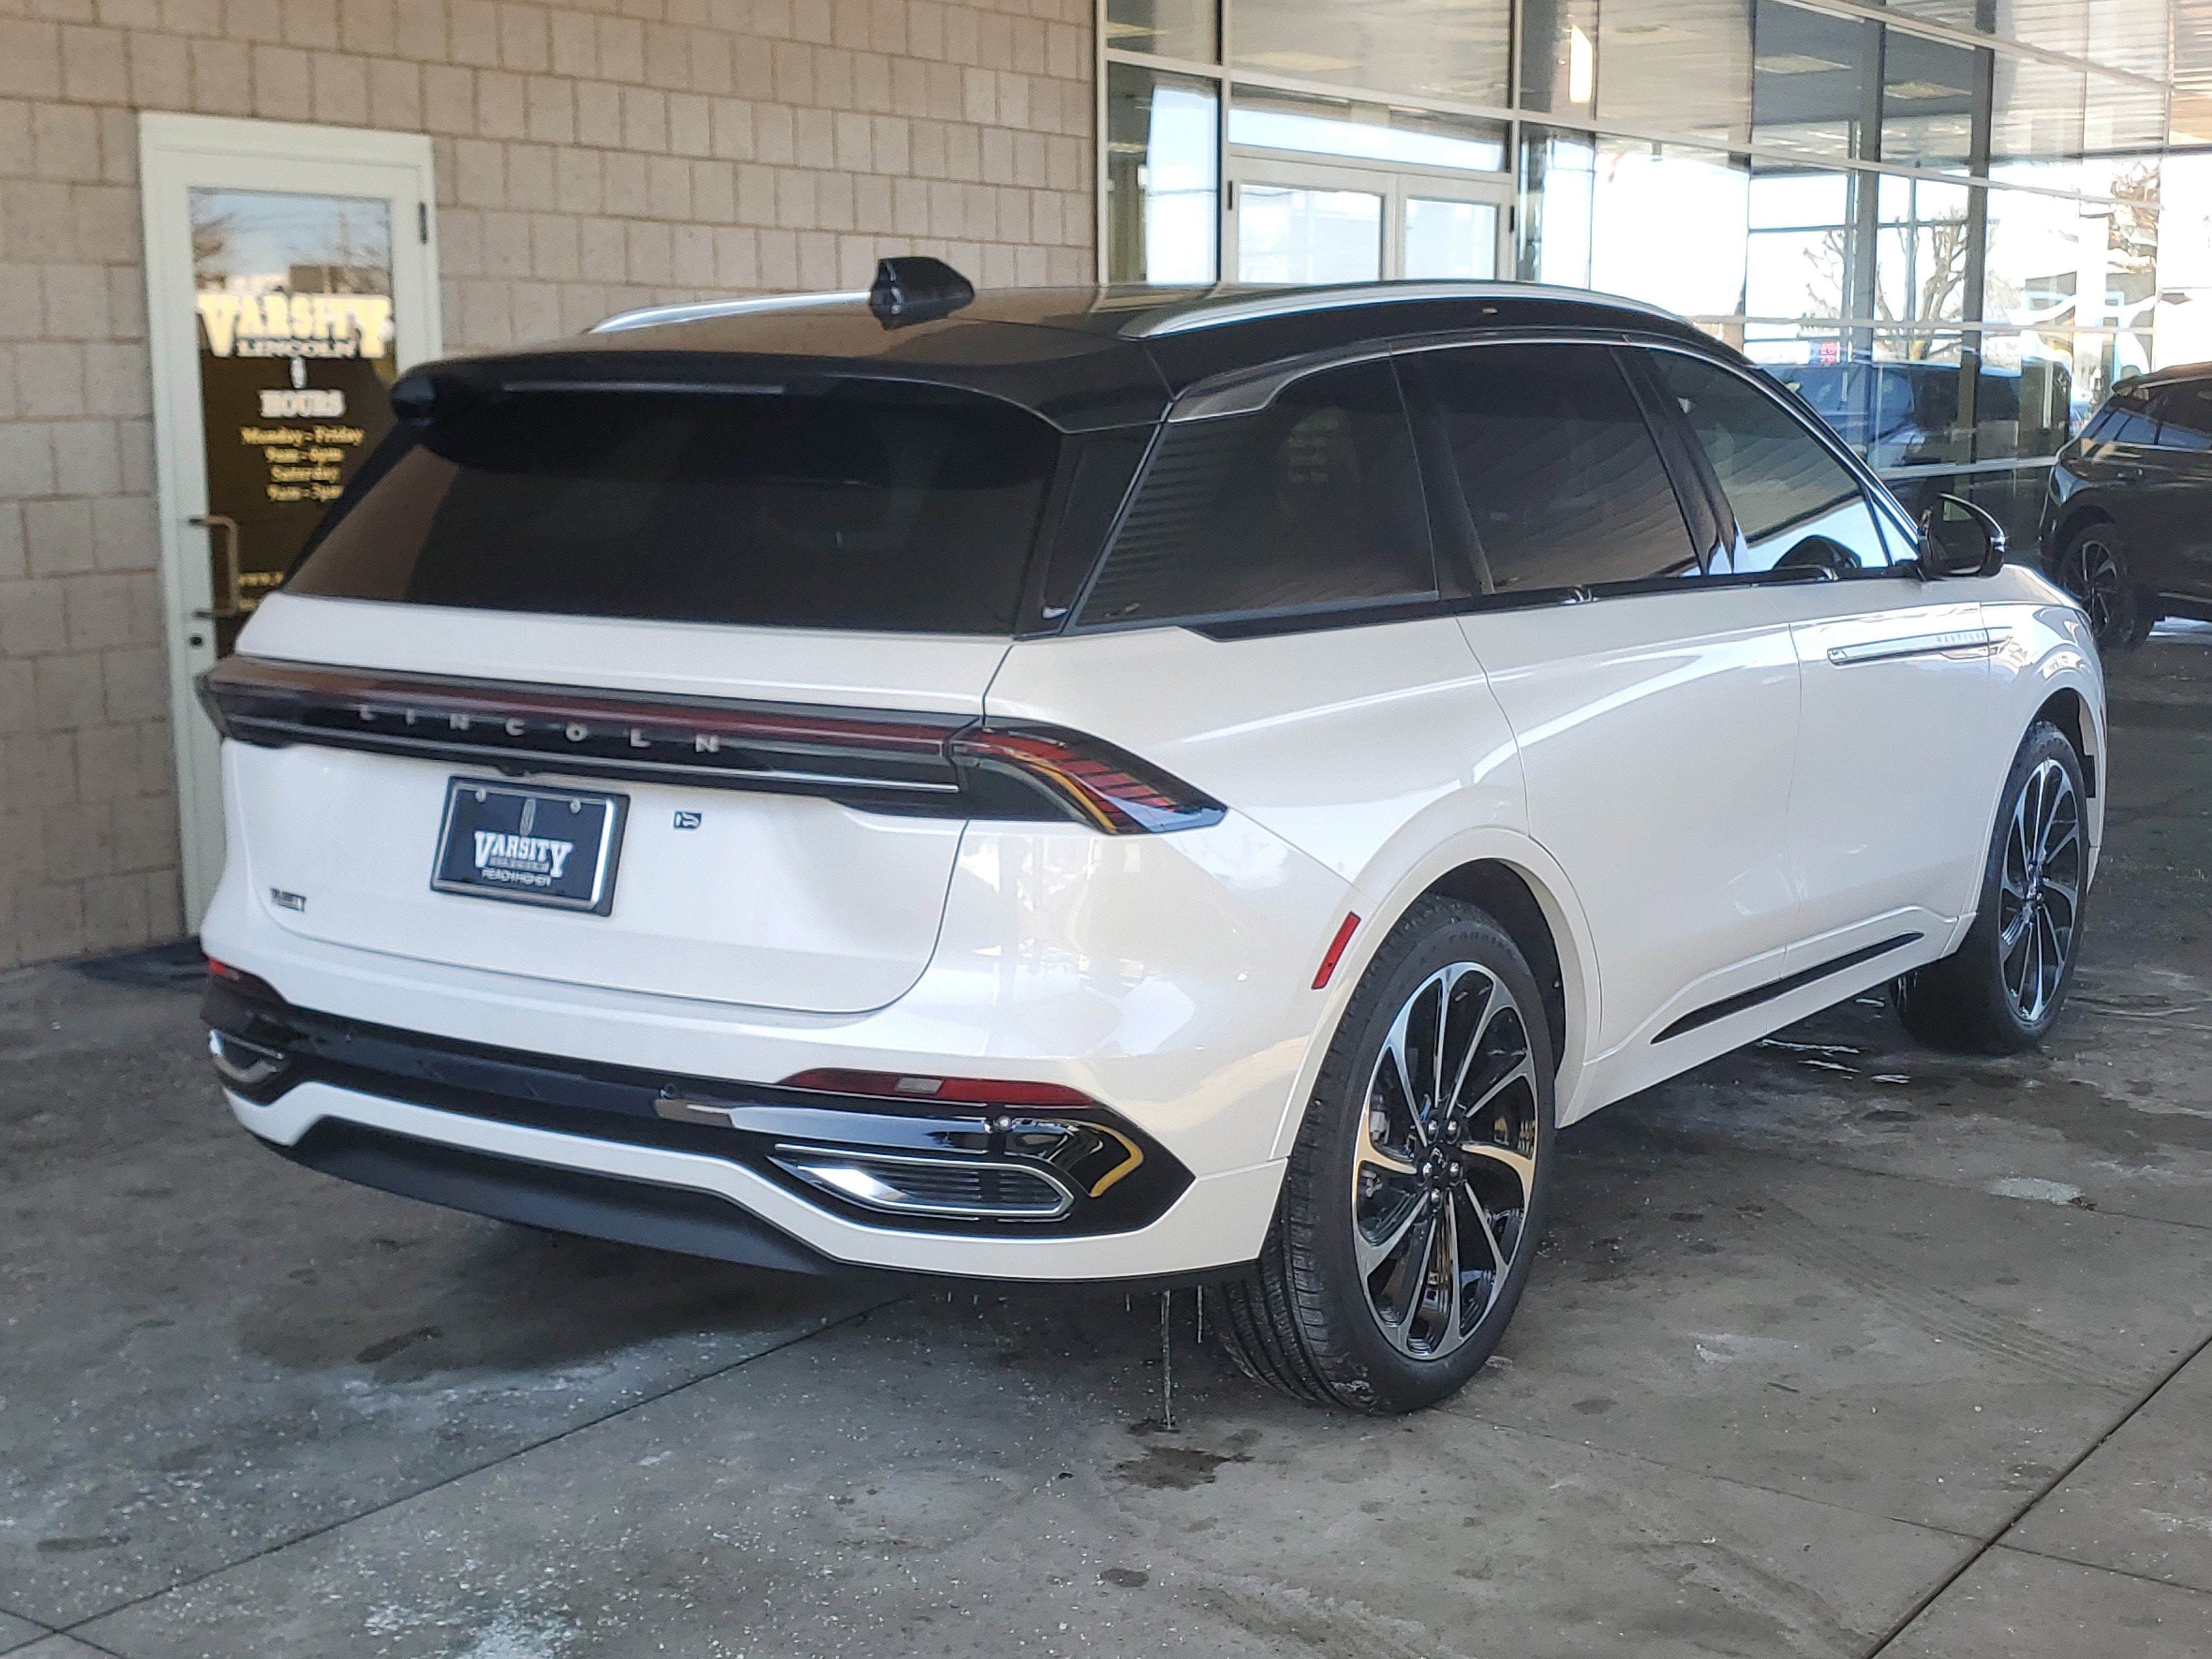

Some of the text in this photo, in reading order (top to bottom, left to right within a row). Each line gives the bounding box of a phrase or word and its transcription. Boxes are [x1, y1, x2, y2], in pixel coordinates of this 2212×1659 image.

[198, 293, 392, 358] VARSITY
[236, 338, 357, 358] LINCOLN
[259, 389, 345, 418] HOURS
[241, 426, 302, 447] Monday
[314, 425, 364, 447] Friday
[359, 704, 720, 753] LINCOLN
[474, 830, 574, 878] VARSITY
